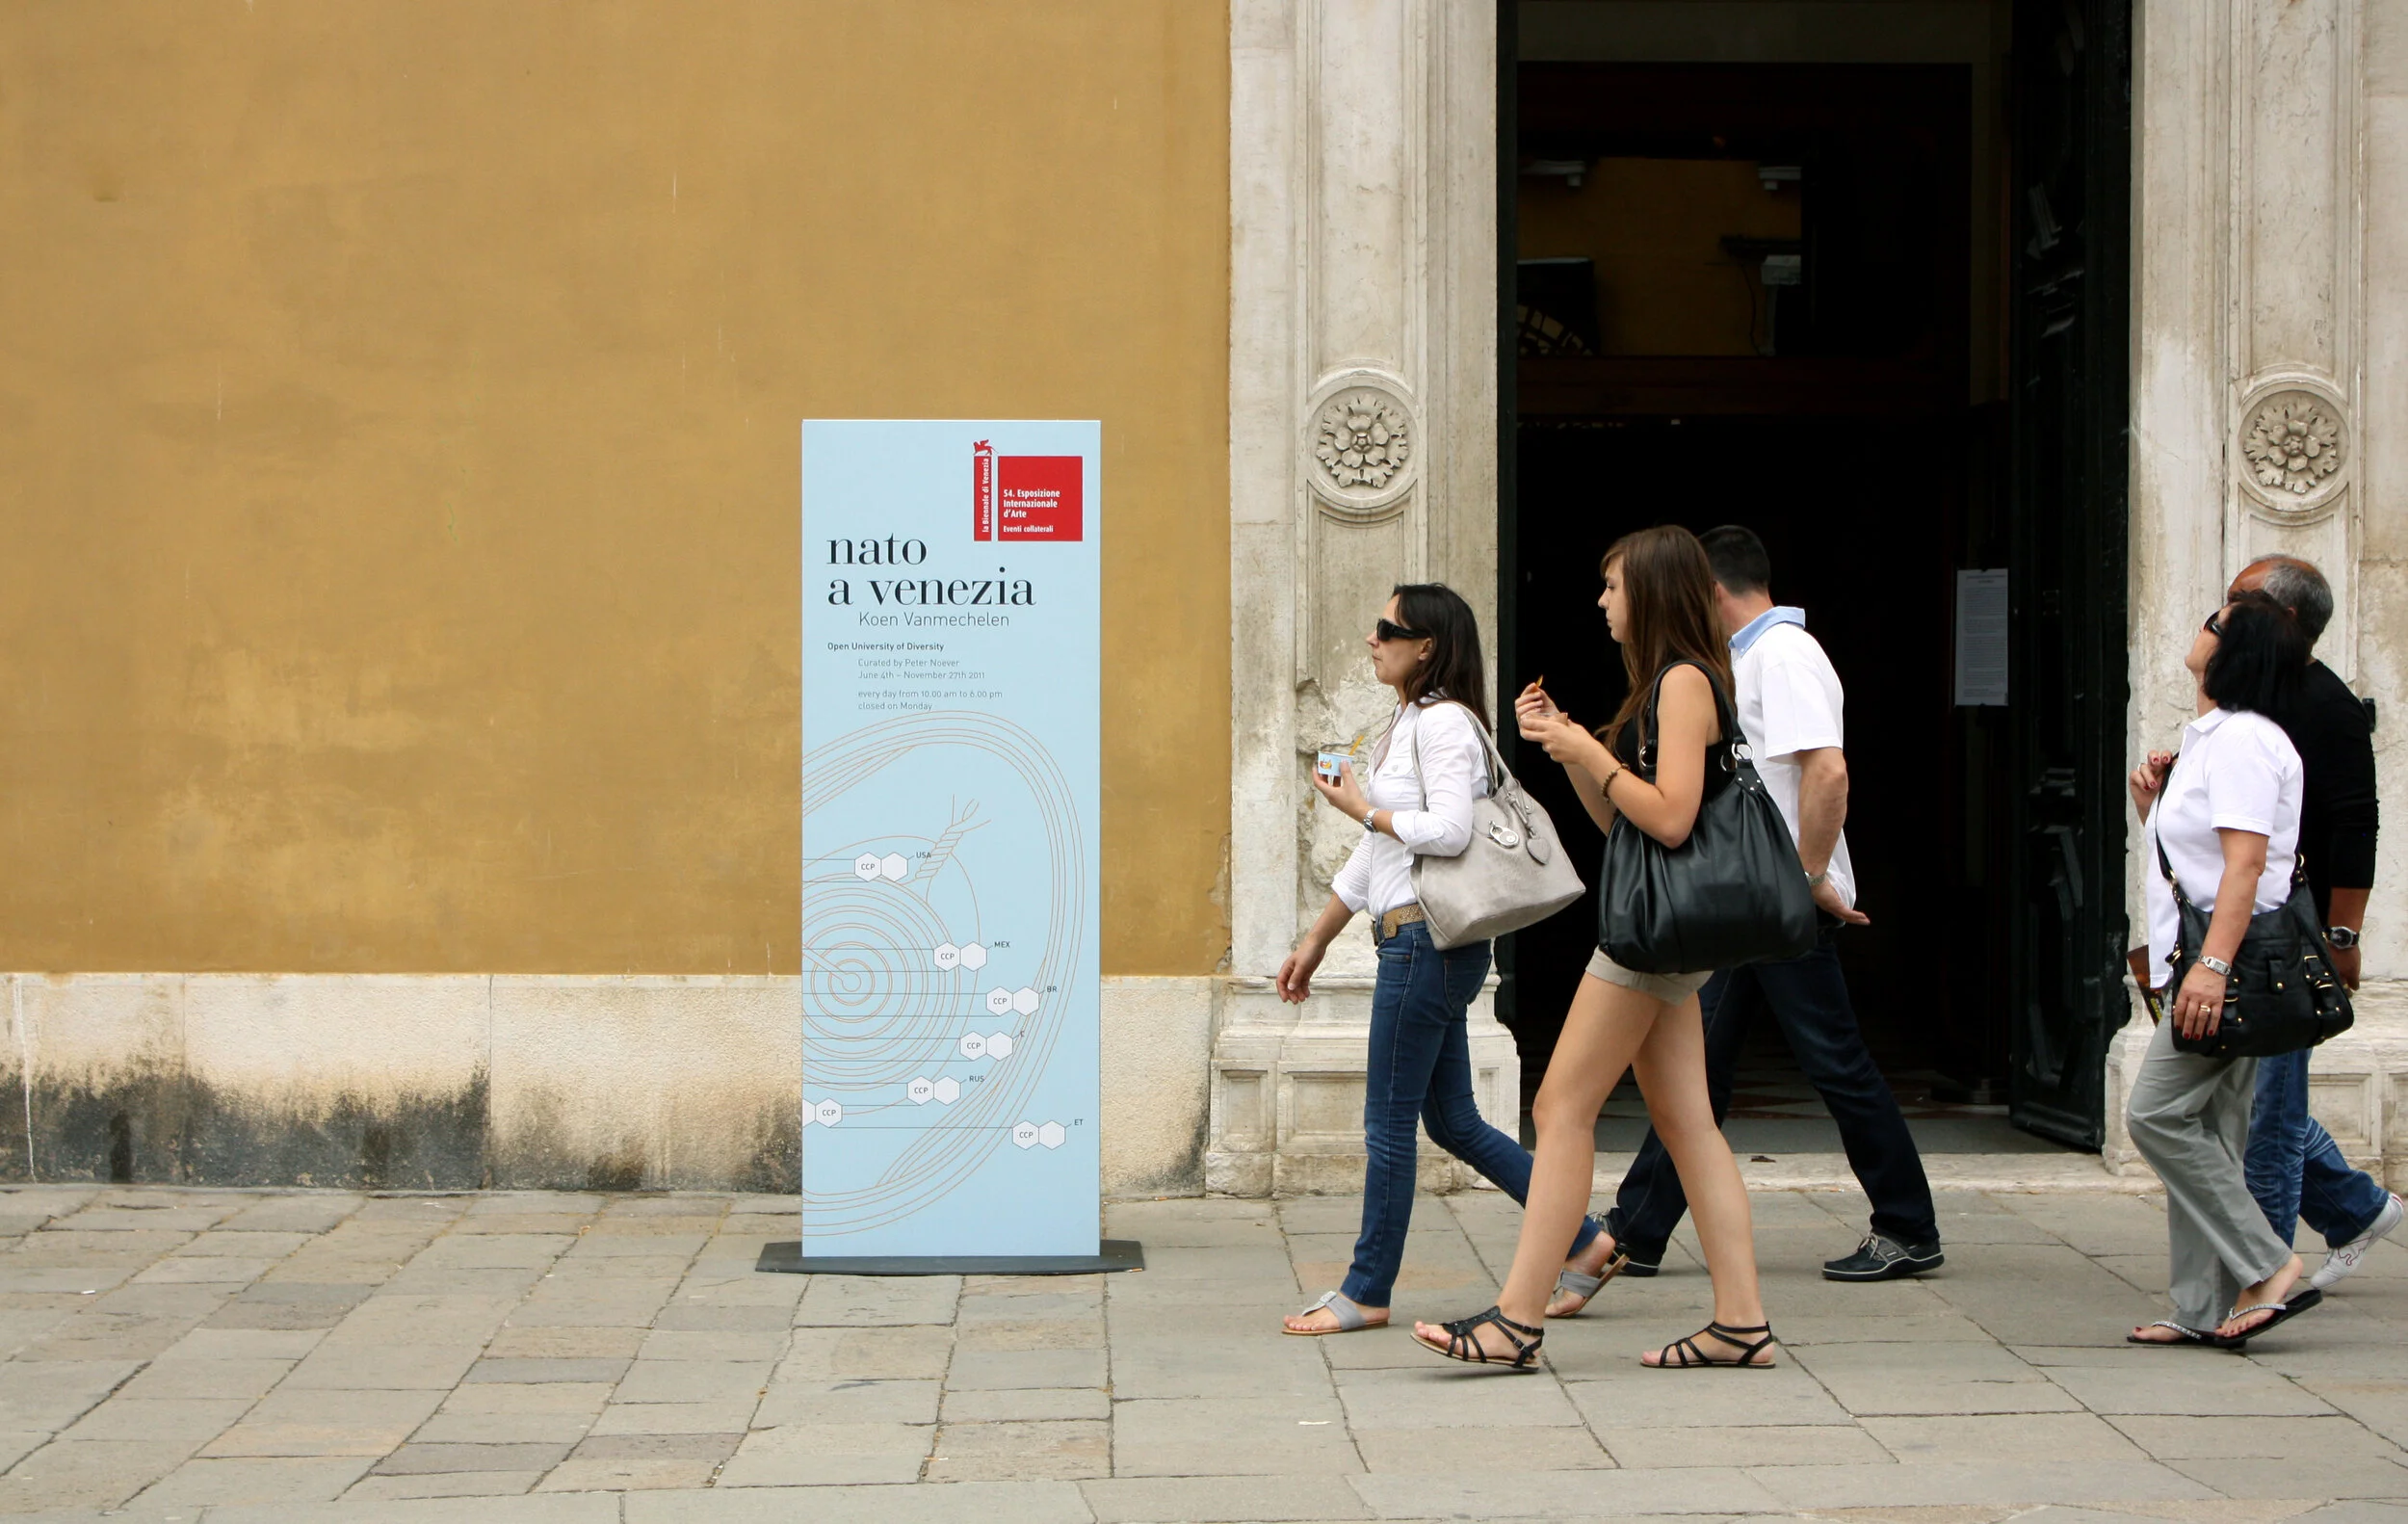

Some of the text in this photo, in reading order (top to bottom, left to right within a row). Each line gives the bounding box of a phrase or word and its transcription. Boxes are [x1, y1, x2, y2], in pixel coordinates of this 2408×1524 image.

[1017, 488, 1060, 499] Esposizione
[1004, 498, 1058, 508] Internazionale
[826, 533, 928, 565] nato
[827, 566, 1036, 606] a venezia
[859, 612, 1009, 627] Koen Vanmechelen
[827, 643, 849, 652] Open
[851, 643, 895, 652] University
[907, 643, 944, 652] Diversity
[858, 658, 891, 667] Curated
[894, 659, 903, 669] by
[880, 670, 894, 679] 4th
[904, 670, 947, 679] November
[948, 670, 966, 679] 27th
[858, 691, 880, 699] every
[882, 690, 897, 699] day
[858, 701, 885, 710] closed
[901, 702, 932, 711] Monday
